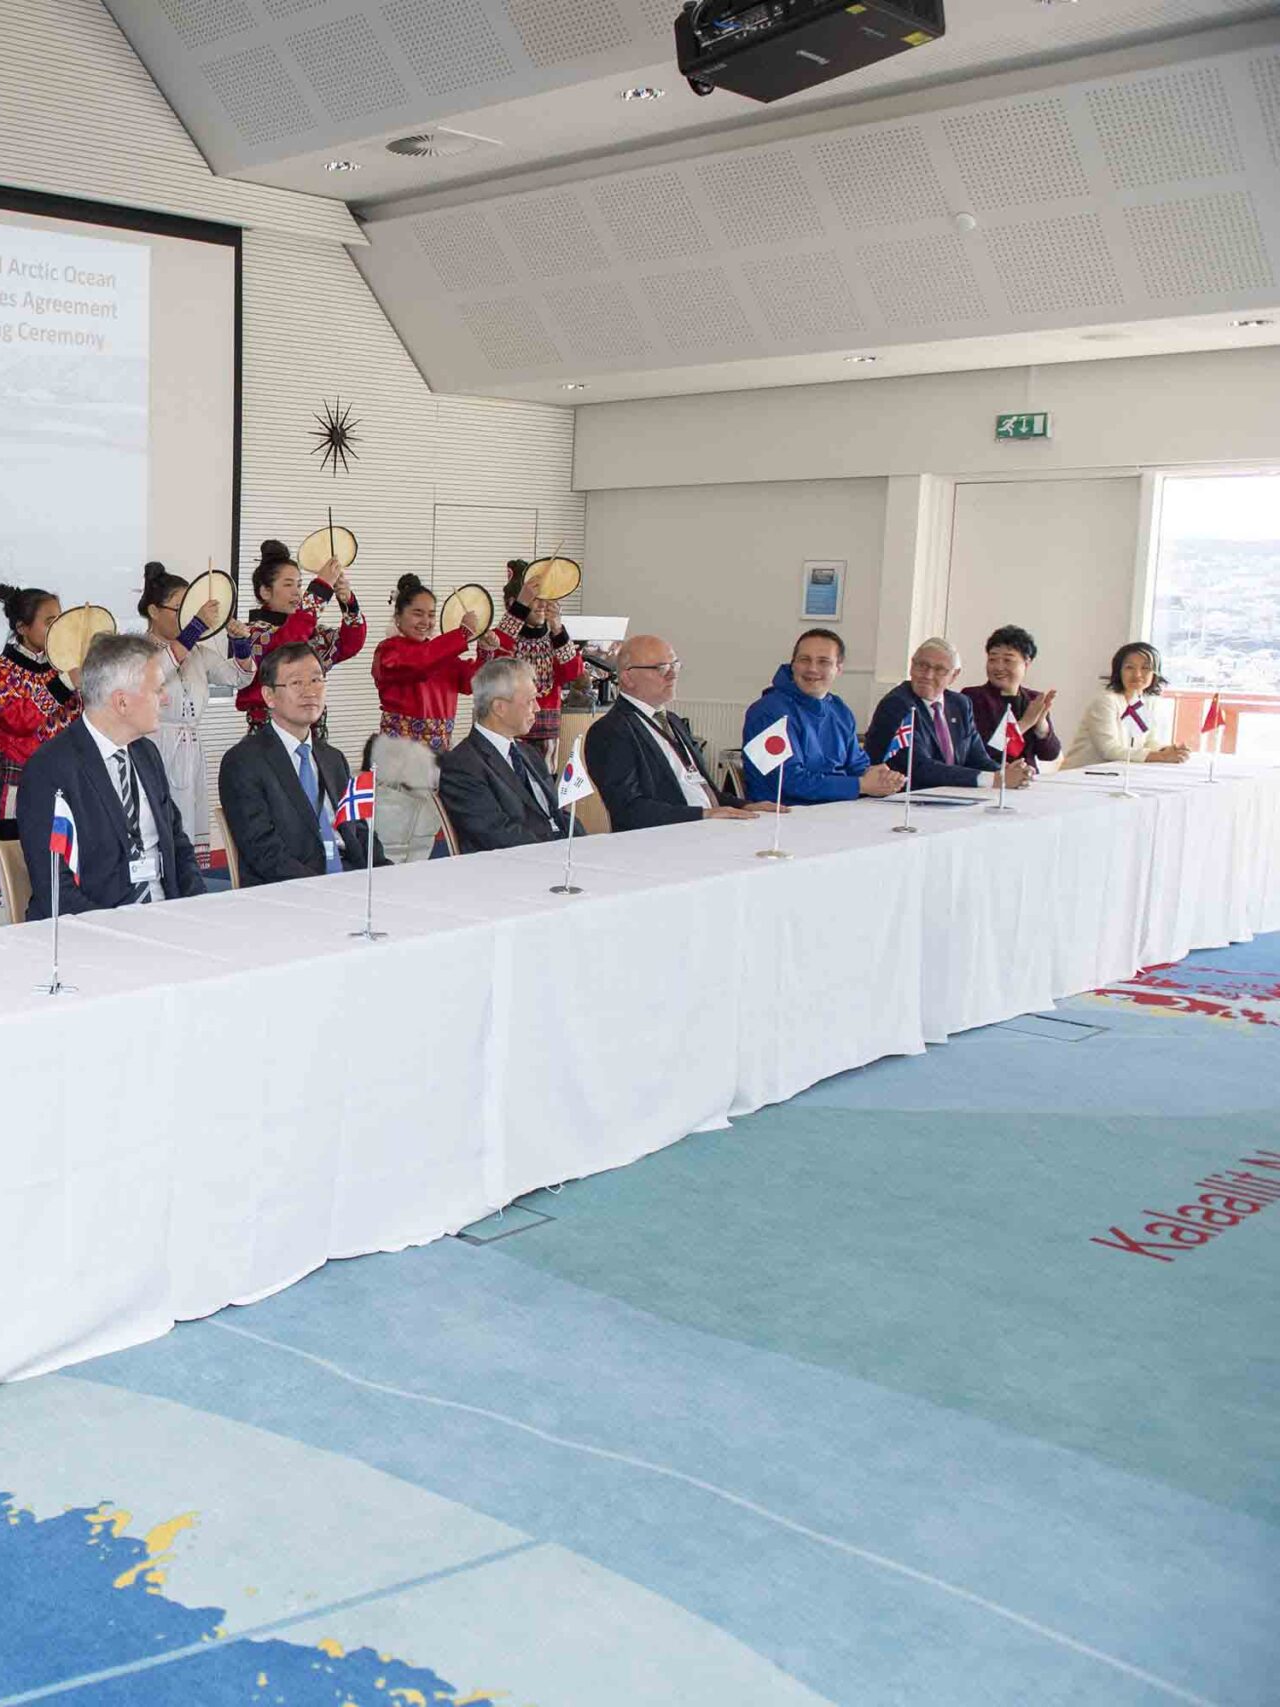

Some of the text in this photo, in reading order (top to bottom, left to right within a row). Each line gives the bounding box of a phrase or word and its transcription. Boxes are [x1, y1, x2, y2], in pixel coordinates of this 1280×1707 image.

[8, 258, 58, 282] Arctic
[64, 265, 117, 288] Ocean
[23, 291, 118, 319] Agreement
[18, 322, 105, 351] Ceremony
[1089, 1170, 1280, 1262] Kalaallit
